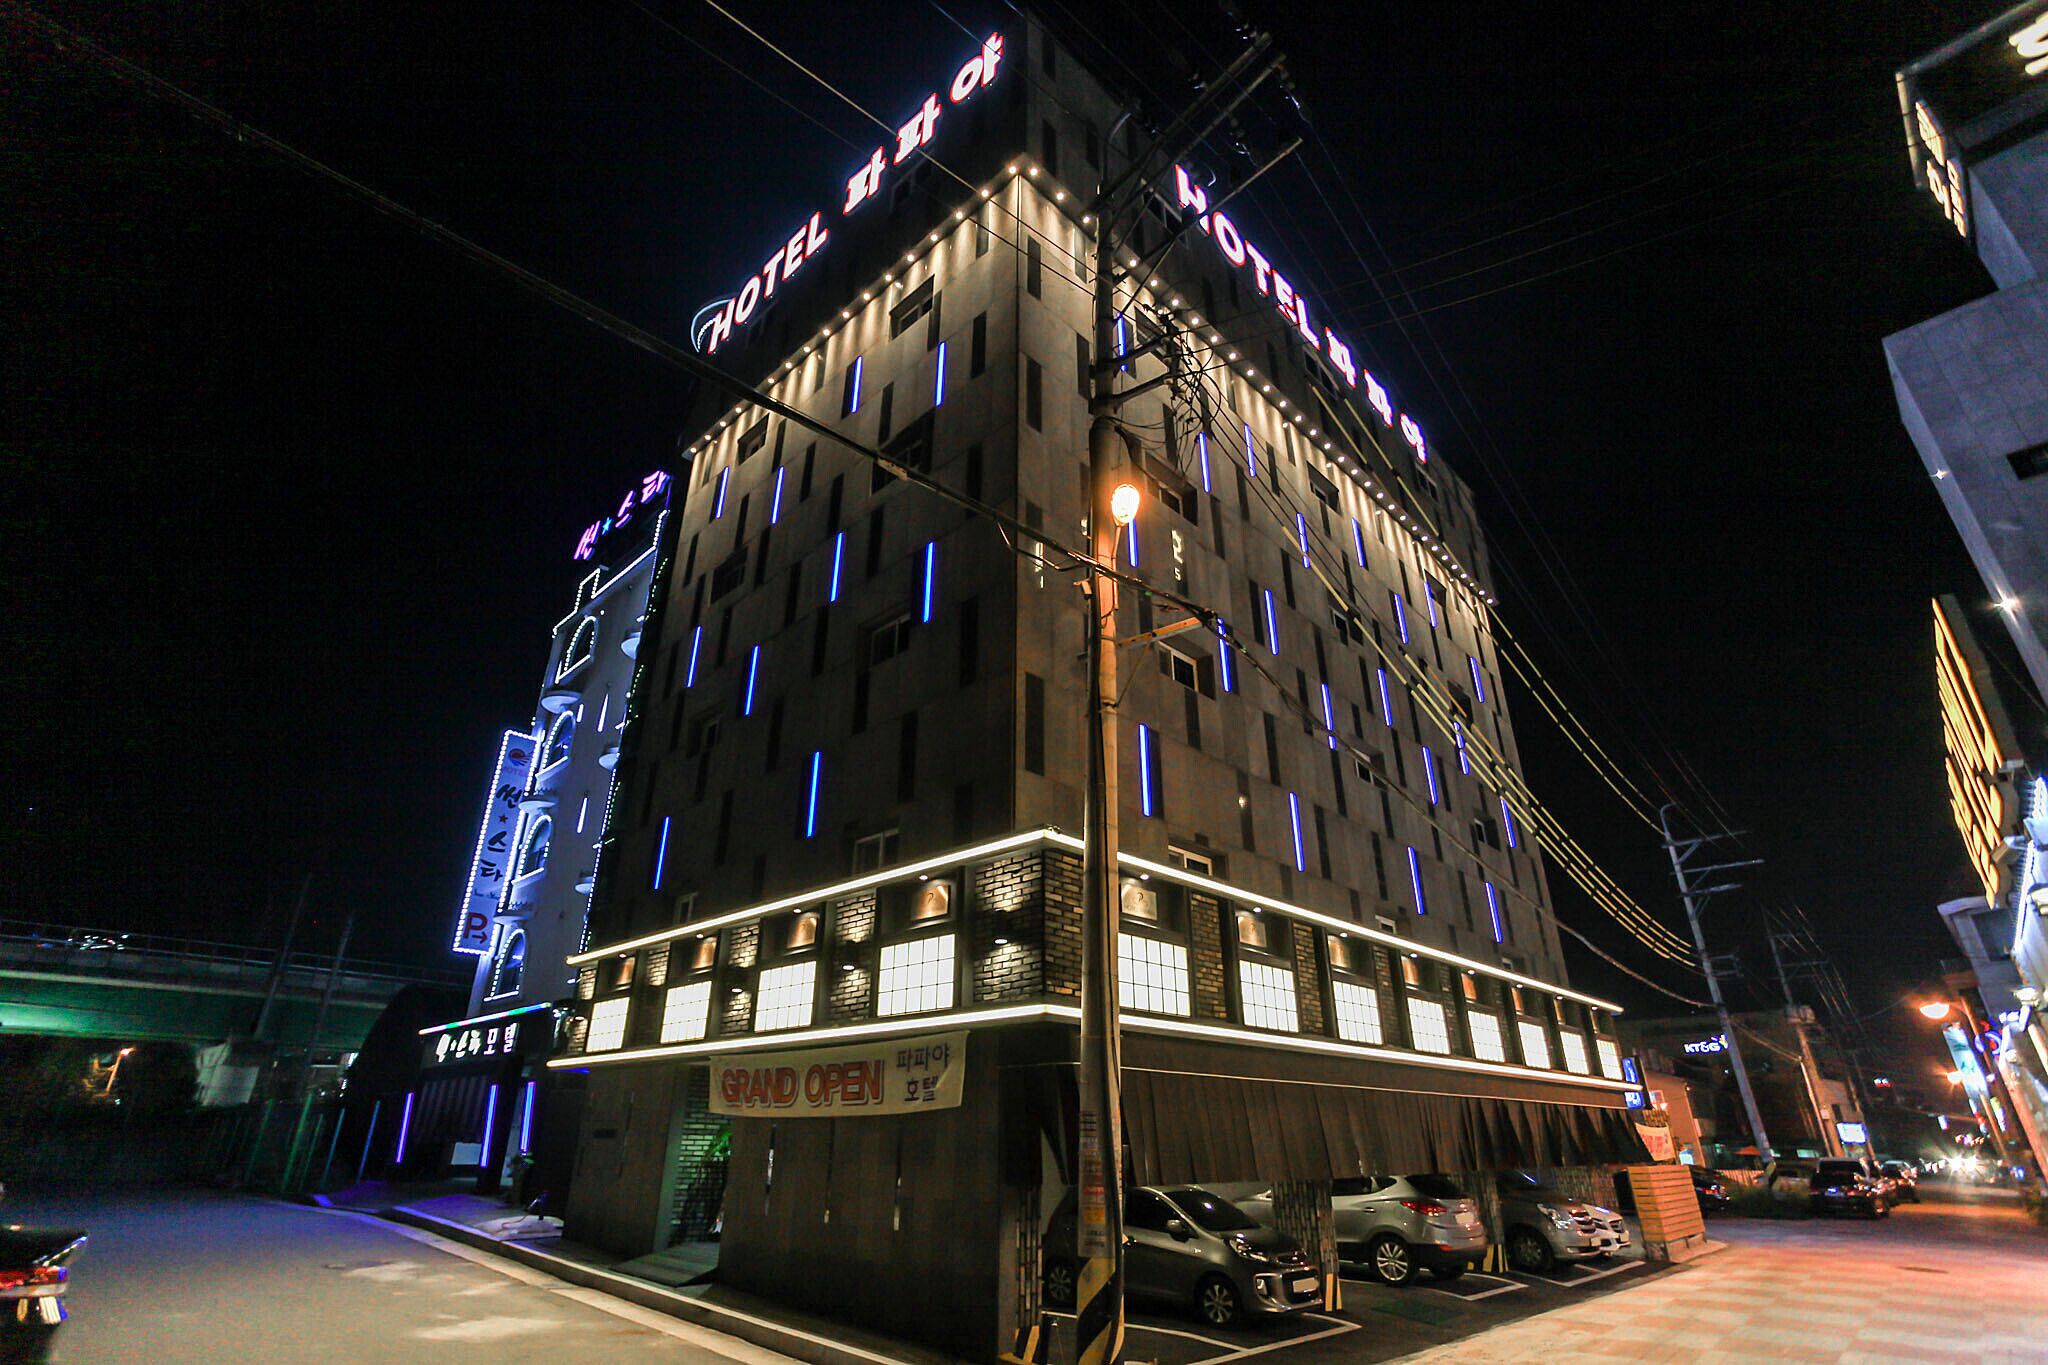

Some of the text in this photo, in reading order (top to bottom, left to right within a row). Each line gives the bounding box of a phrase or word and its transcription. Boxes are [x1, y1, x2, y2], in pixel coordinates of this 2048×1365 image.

[708, 32, 1004, 354] HOTEL 파파야
[1175, 164, 1427, 464] HOTEL 파파야
[463, 912, 488, 939] P
[484, 1023, 517, 1055] 모텔
[1684, 1041, 1720, 1053] KT&G
[896, 1042, 950, 1072] 파파야
[721, 1060, 884, 1107] GRAND OPEN
[904, 1075, 939, 1102] 호텔
